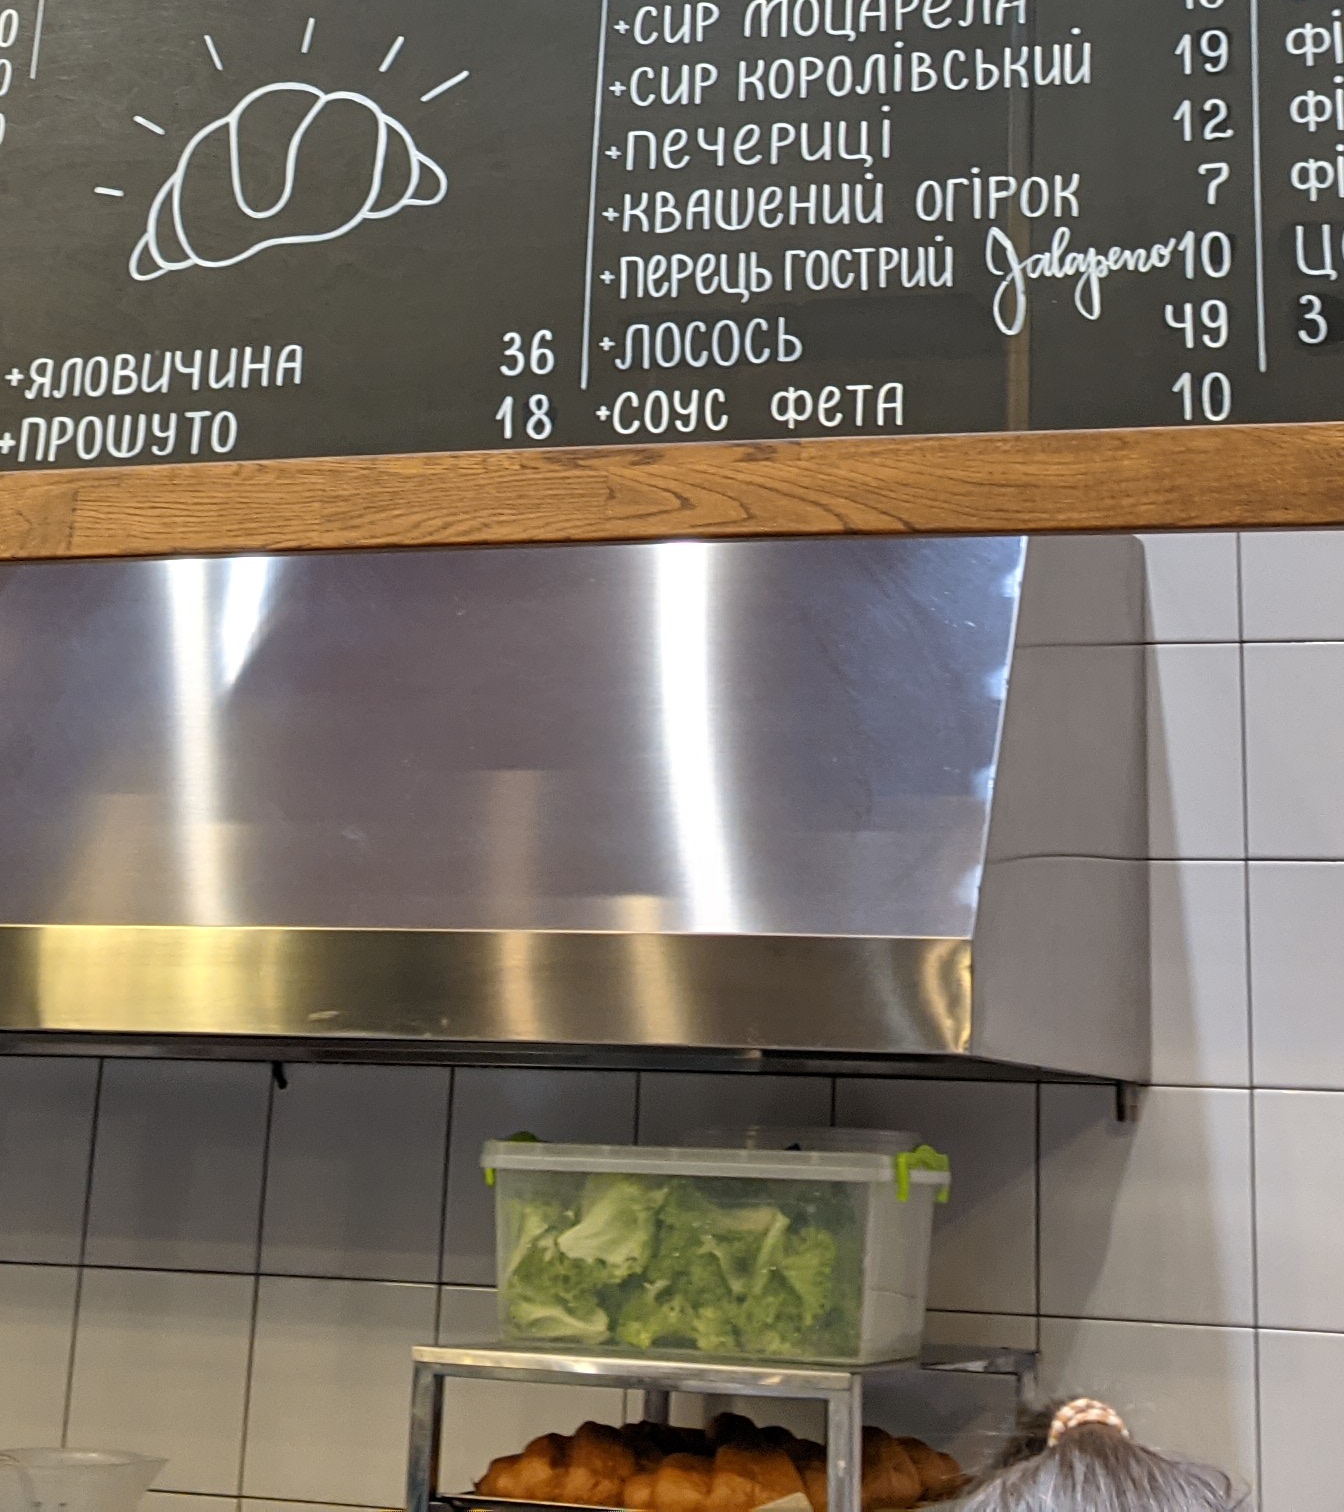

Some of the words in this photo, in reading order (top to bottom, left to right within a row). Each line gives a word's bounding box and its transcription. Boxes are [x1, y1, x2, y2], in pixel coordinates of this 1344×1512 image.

[737, 27, 1092, 102] КОРОЛІВСЬКИЙ
[1172, 98, 1235, 142] 12
[915, 166, 1081, 222] ОГІРОК
[1197, 161, 1230, 205] 7
[783, 234, 955, 292] ГОСТРИЙ
[985, 226, 1178, 336] Jalapeno
[1164, 298, 1230, 350] 49
[499, 329, 555, 377] 36
